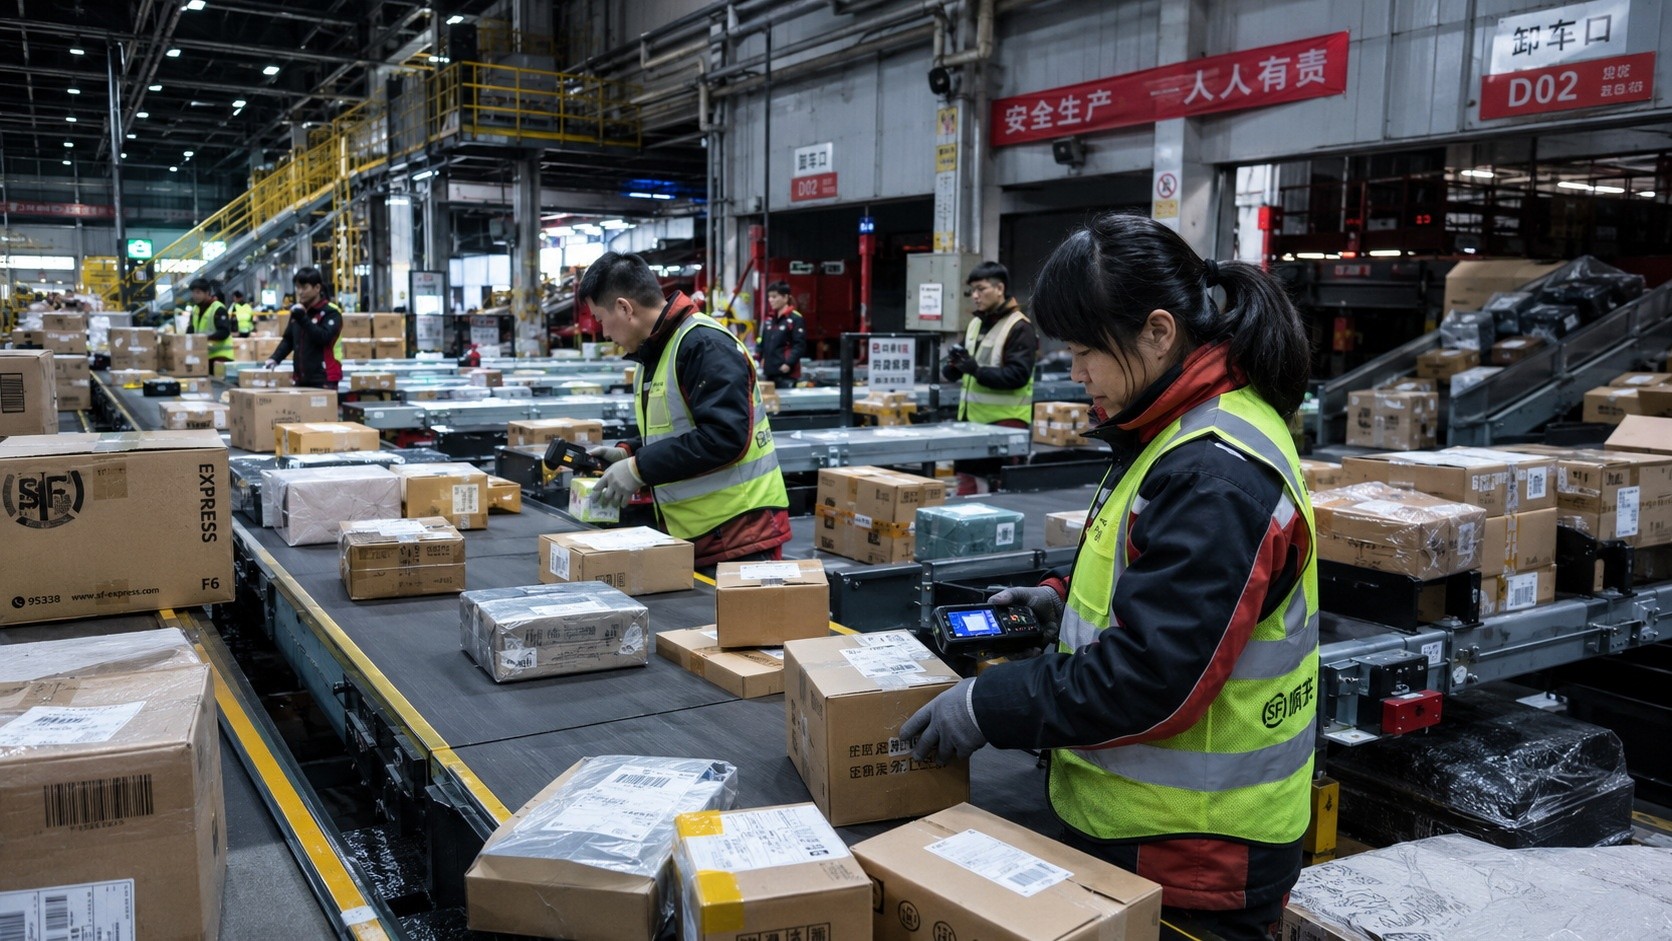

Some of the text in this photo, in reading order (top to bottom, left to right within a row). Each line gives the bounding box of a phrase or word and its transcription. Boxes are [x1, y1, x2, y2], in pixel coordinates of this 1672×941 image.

[1512, 15, 1612, 56] 卸车口
[1508, 71, 1579, 107] D02
[1005, 89, 1112, 135] 安全生产
[199, 463, 218, 543] EXPRESS
[71, 587, 160, 601] www.sf-express.com
[202, 577, 220, 590] F6
[1266, 700, 1284, 721] SF
